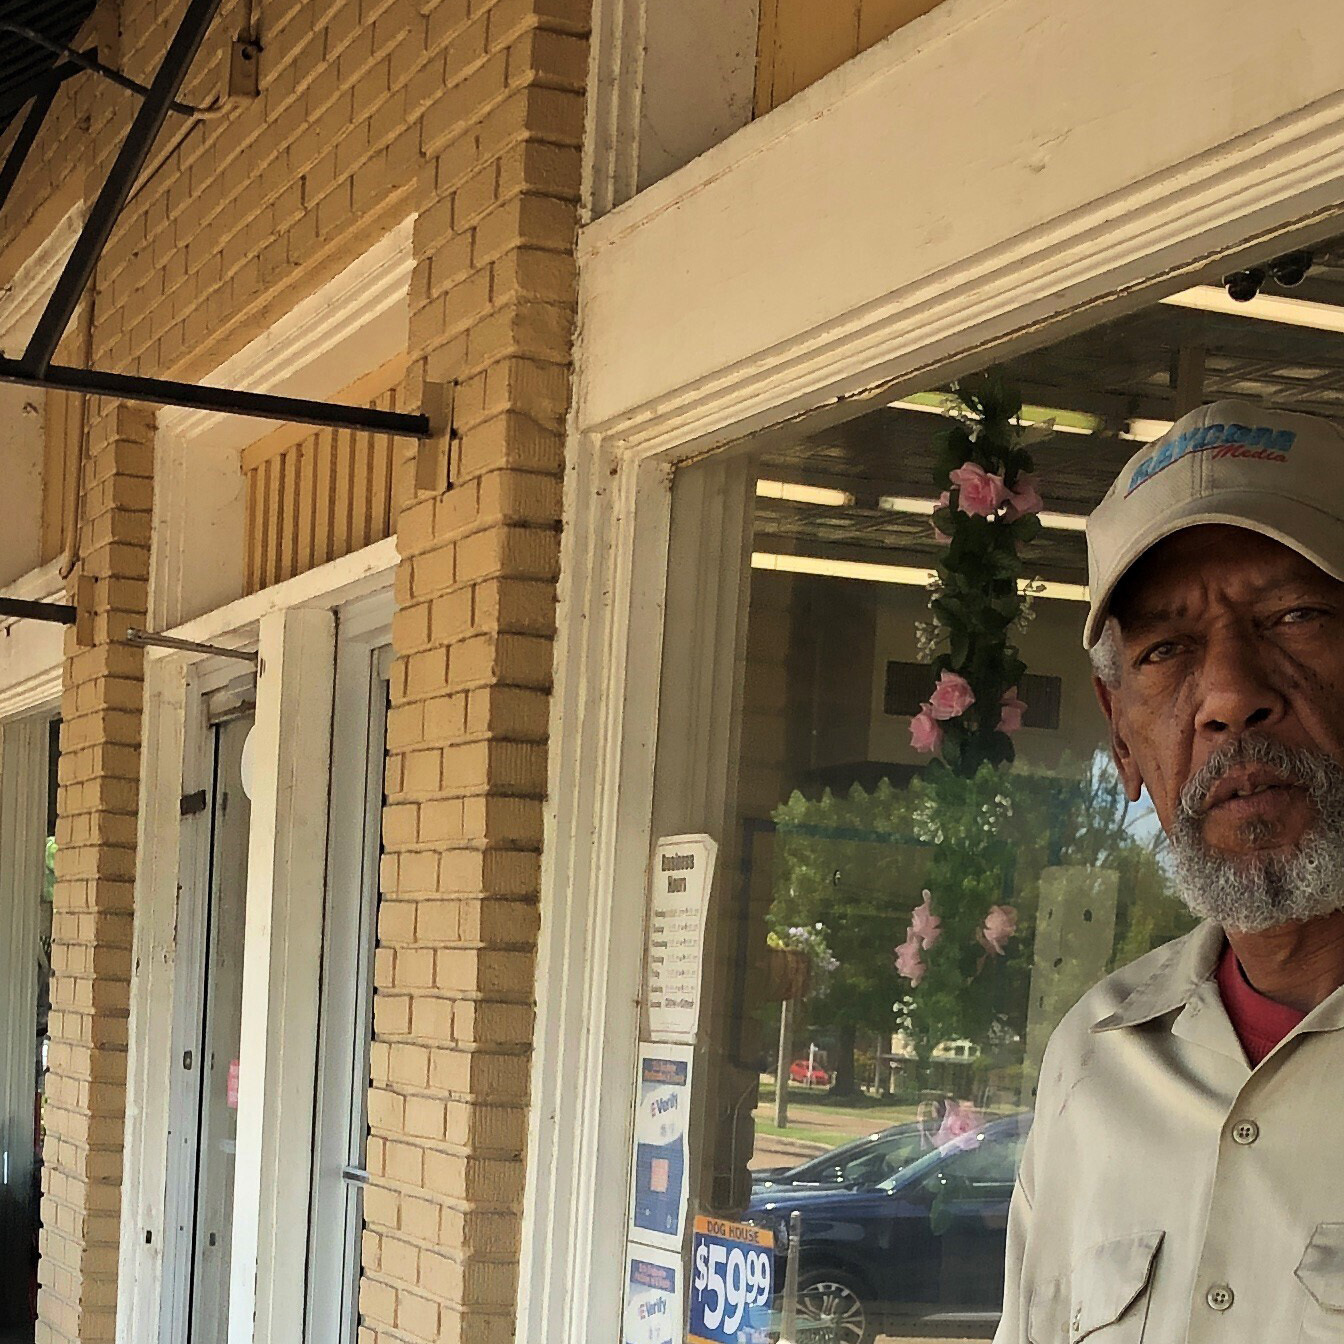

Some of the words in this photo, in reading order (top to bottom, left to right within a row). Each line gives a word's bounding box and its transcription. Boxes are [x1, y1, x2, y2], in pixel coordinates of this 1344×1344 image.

[1212, 443, 1289, 462] Media
[707, 1220, 726, 1237] DOG
[728, 1226, 760, 1244] HOUSE
